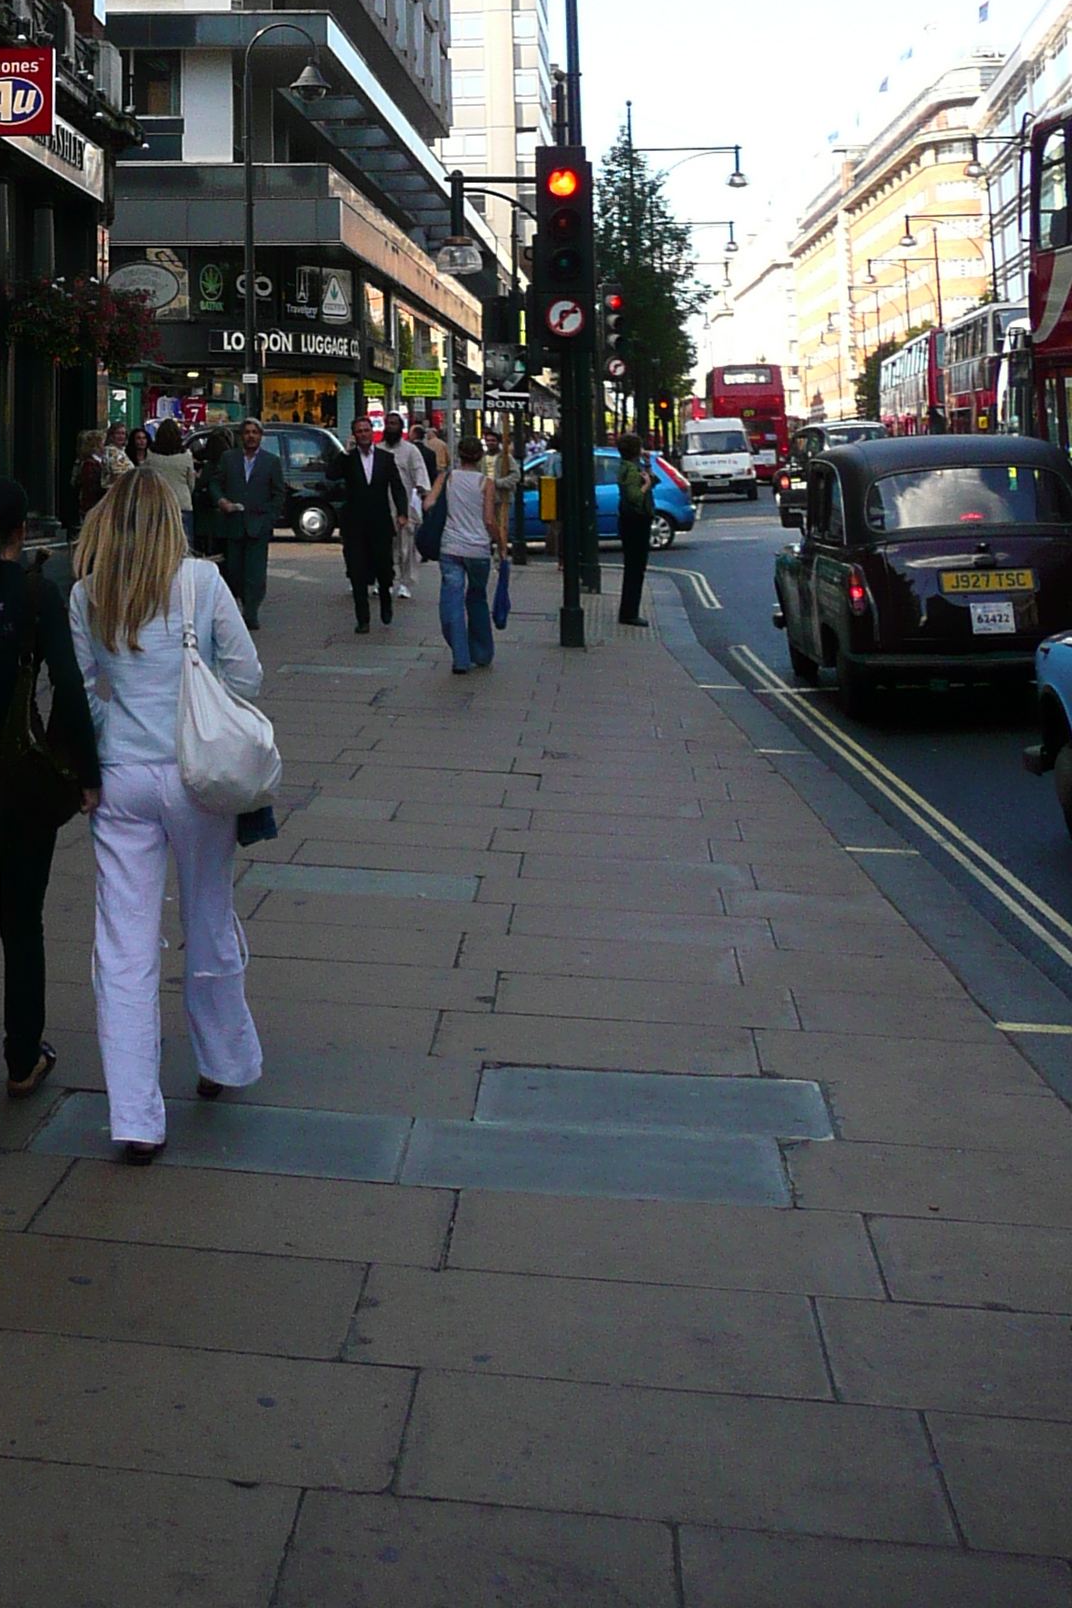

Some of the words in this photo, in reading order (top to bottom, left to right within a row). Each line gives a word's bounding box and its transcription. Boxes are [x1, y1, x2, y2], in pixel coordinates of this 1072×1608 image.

[223, 330, 293, 352] LODON
[301, 335, 349, 355] LUGGAGE
[486, 399, 527, 410] SONY
[190, 408, 199, 423] 7
[951, 574, 990, 589] J927
[994, 572, 1027, 587] TSC
